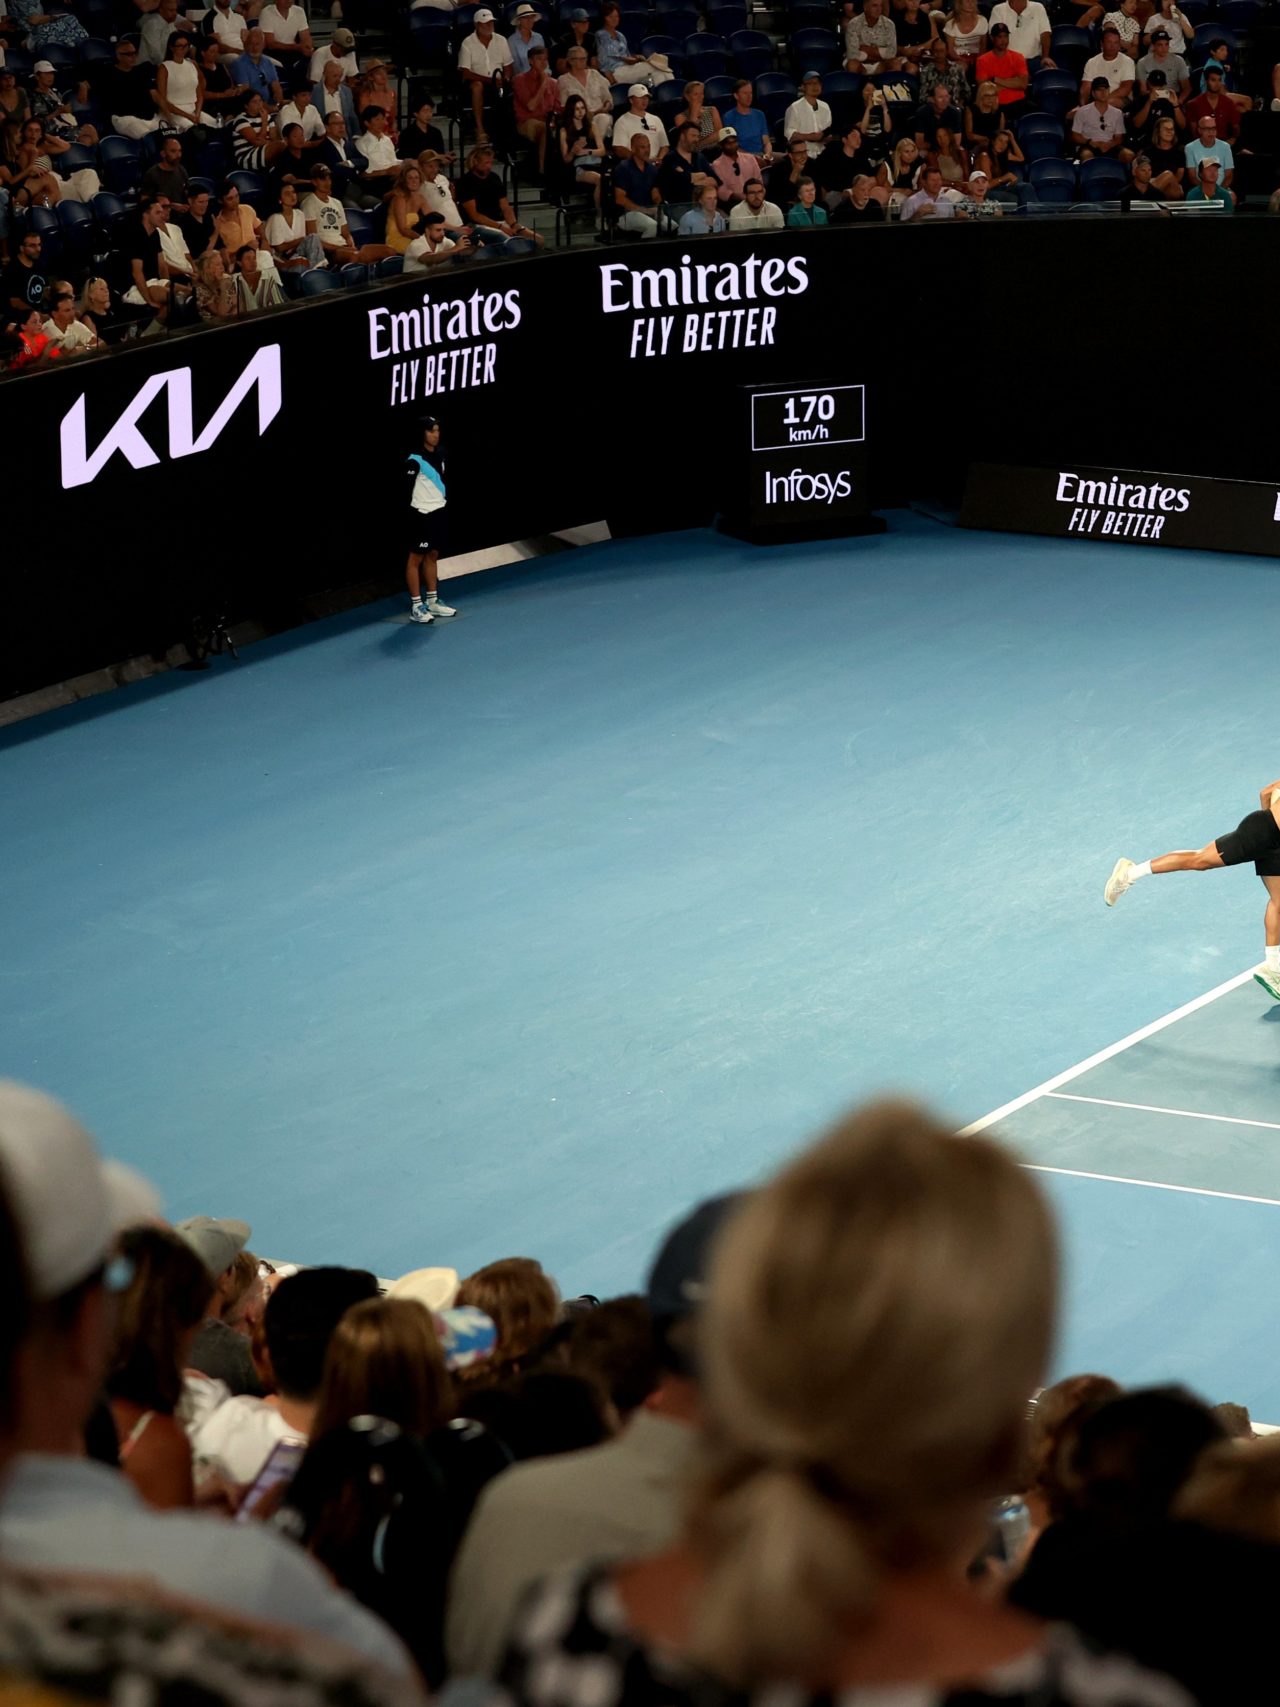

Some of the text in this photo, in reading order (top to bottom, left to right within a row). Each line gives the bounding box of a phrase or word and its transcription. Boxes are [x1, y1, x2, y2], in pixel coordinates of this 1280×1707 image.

[600, 254, 809, 313] Emirates
[368, 289, 522, 360] Emirates
[631, 307, 777, 358] FLY BETTER
[391, 343, 497, 406] FLY BETTER
[60, 343, 282, 490] KIA
[784, 394, 835, 424] 170
[789, 424, 829, 442] km/h
[765, 468, 852, 504] Infosys
[1056, 473, 1191, 512] Emirates
[1069, 507, 1166, 539] FLY BETTER
